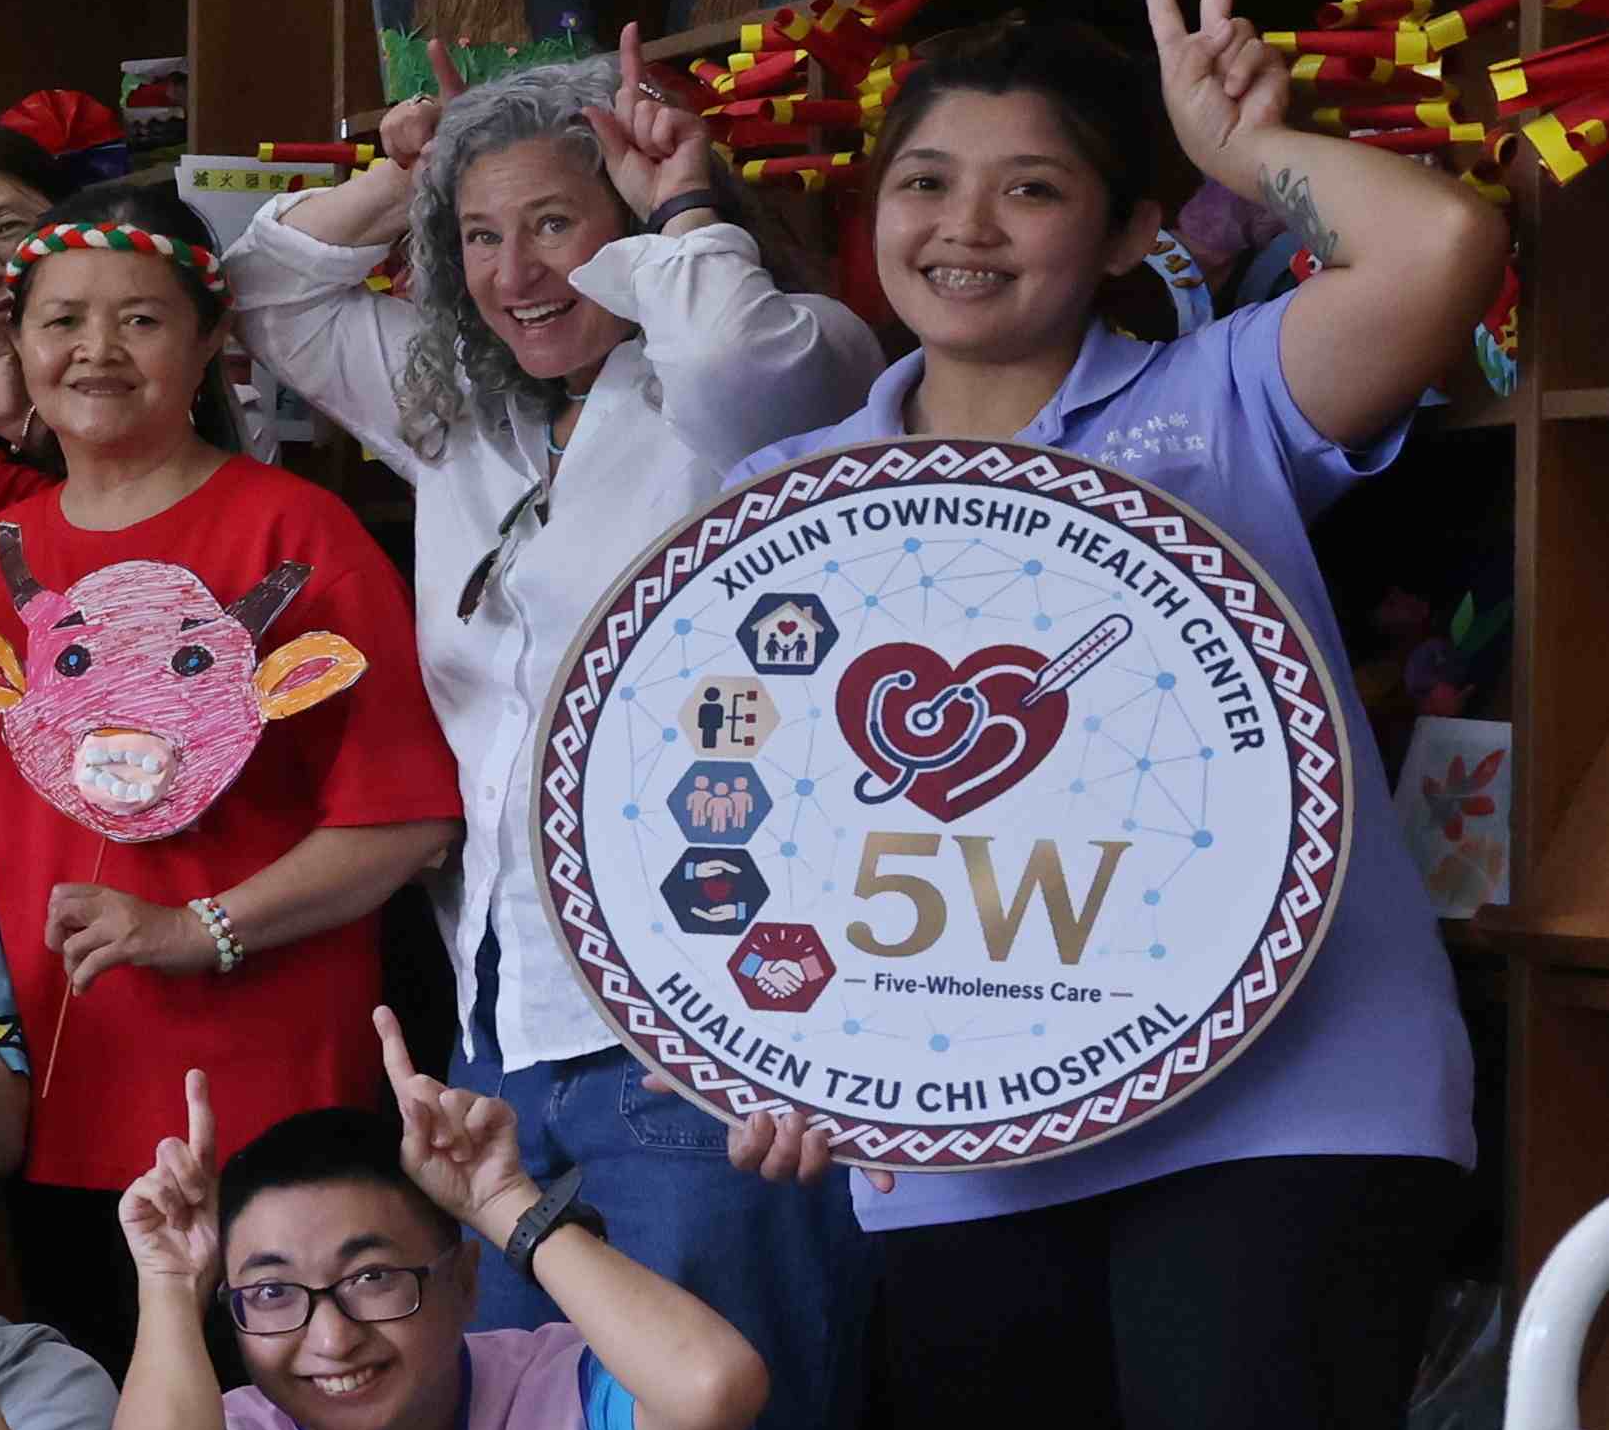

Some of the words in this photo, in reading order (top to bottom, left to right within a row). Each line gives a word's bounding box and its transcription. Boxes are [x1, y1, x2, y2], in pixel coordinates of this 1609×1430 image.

[713, 516, 832, 601] XIULIN
[837, 496, 1051, 540] TOWNSHIP
[1057, 519, 1190, 618] HEALTH
[1180, 616, 1266, 755] CENTER
[845, 830, 1134, 966] 5W
[656, 971, 812, 1090] HUALIEN
[824, 1068, 903, 1112] TZU
[915, 1082, 990, 1117] CHI
[998, 999, 1190, 1110] HOSPITAL
[873, 972, 1044, 1001] Five-Wholeness
[1050, 981, 1102, 1003] Care
